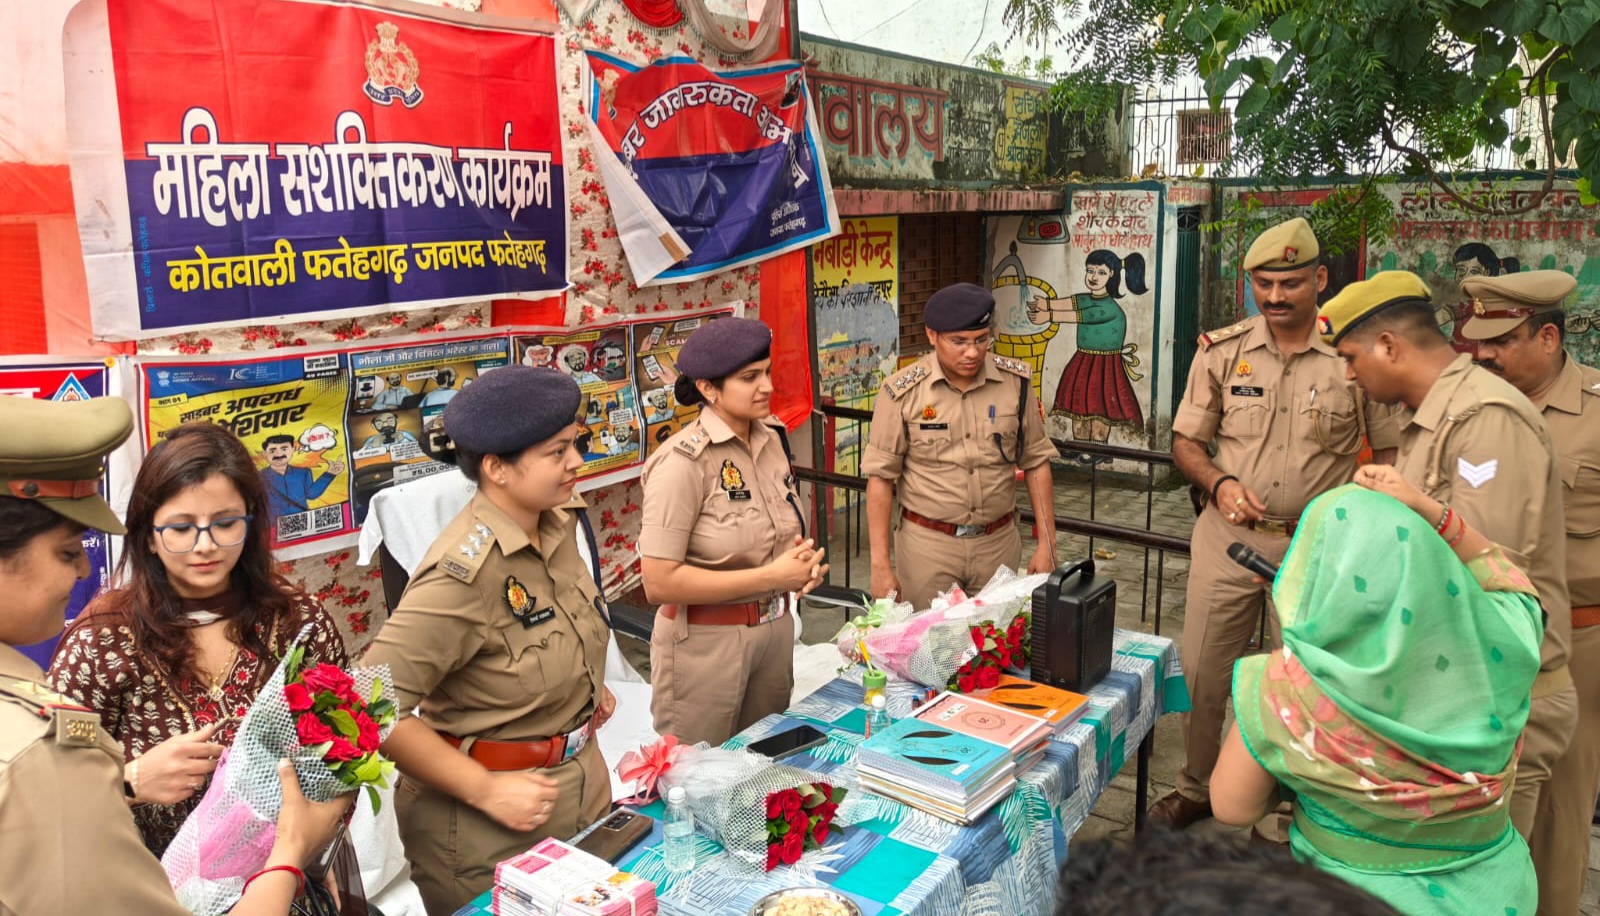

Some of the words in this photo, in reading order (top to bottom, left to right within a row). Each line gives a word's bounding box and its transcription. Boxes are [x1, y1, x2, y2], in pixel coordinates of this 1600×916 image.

[639, 81, 759, 129] जागरुकता
[805, 72, 952, 163] वालय
[146, 107, 272, 227] महिला
[274, 110, 460, 216] सशक्तिकरण
[457, 122, 553, 222] कार्यक्रम
[166, 238, 297, 292] कोतवाली
[303, 237, 409, 284] फतेहगढ़
[412, 240, 485, 272] जनपद
[485, 231, 547, 274] फतेहगढ़
[859, 220, 894, 270] केन्द्र
[358, 355, 382, 366] भोला
[415, 347, 445, 360] डिजिटल
[180, 402, 222, 423] साइबर
[224, 387, 305, 415] अपराध
